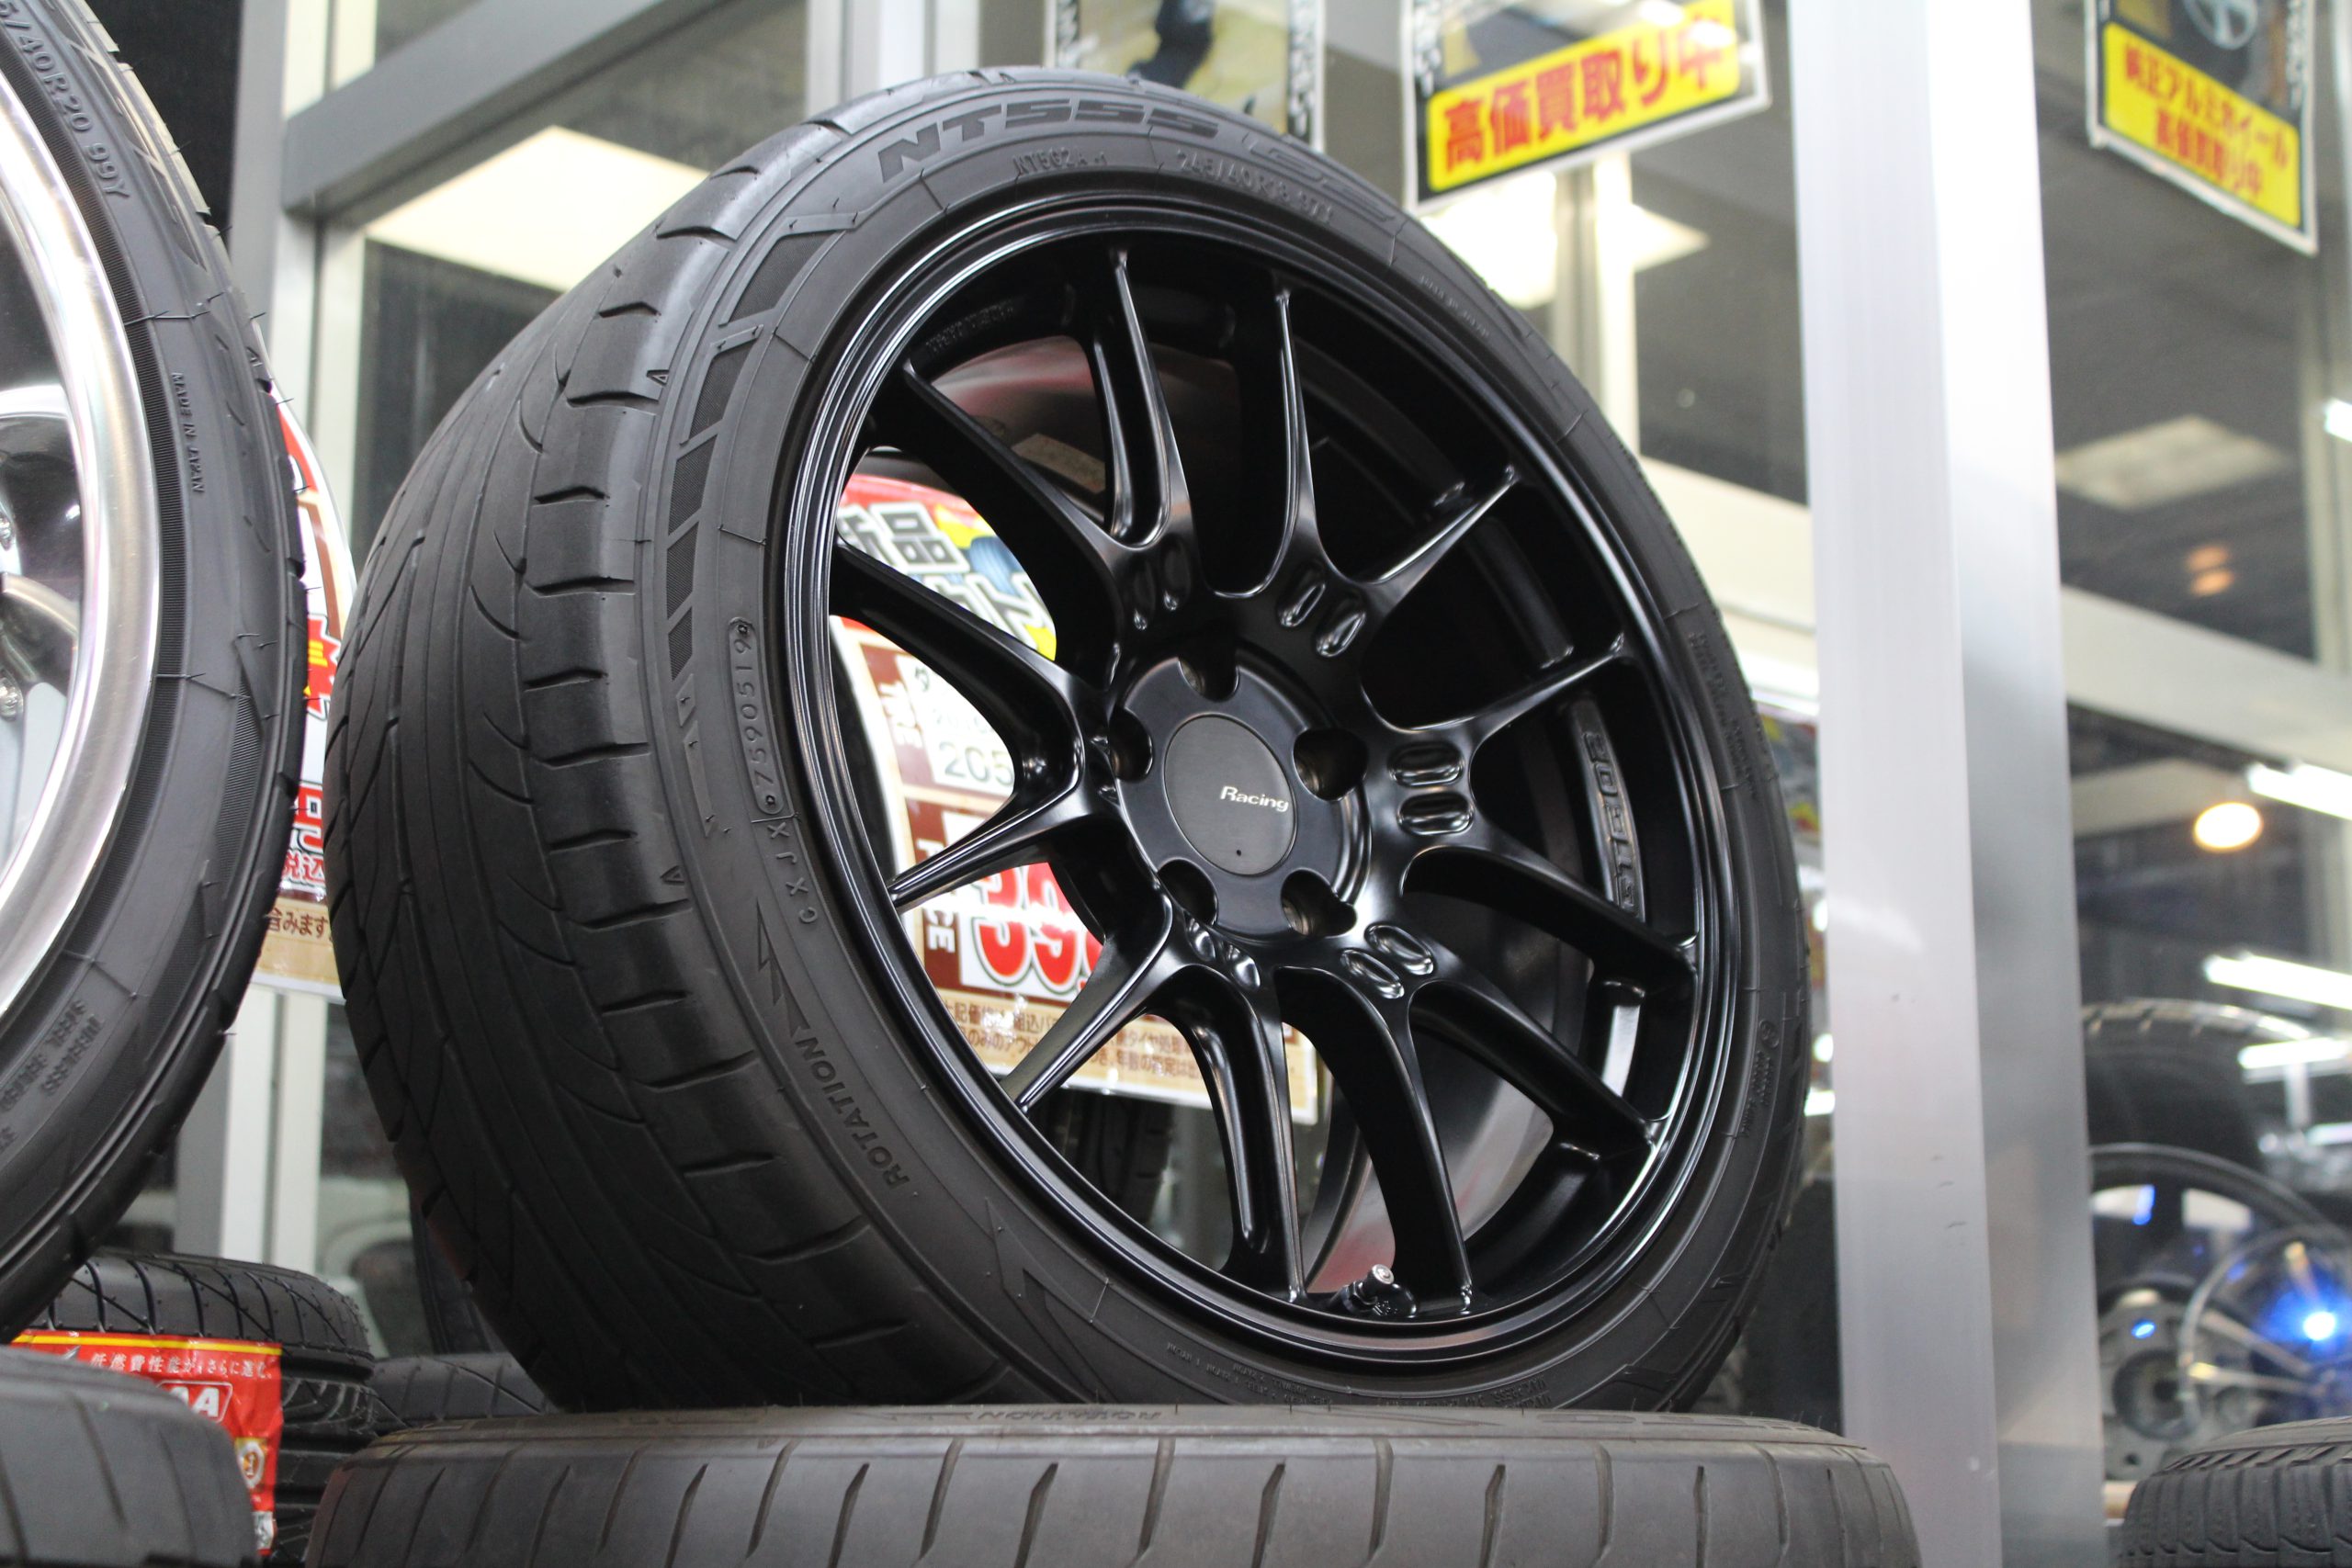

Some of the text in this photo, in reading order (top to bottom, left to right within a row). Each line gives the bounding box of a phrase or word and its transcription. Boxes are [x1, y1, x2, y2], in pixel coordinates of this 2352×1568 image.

[85, 142, 130, 198] 99Y
[878, 97, 1219, 184] NT555
[172, 372, 205, 493] MADE IN JAPAN
[1219, 785, 1289, 813] Racing
[796, 1037, 910, 1189] ROTATION
